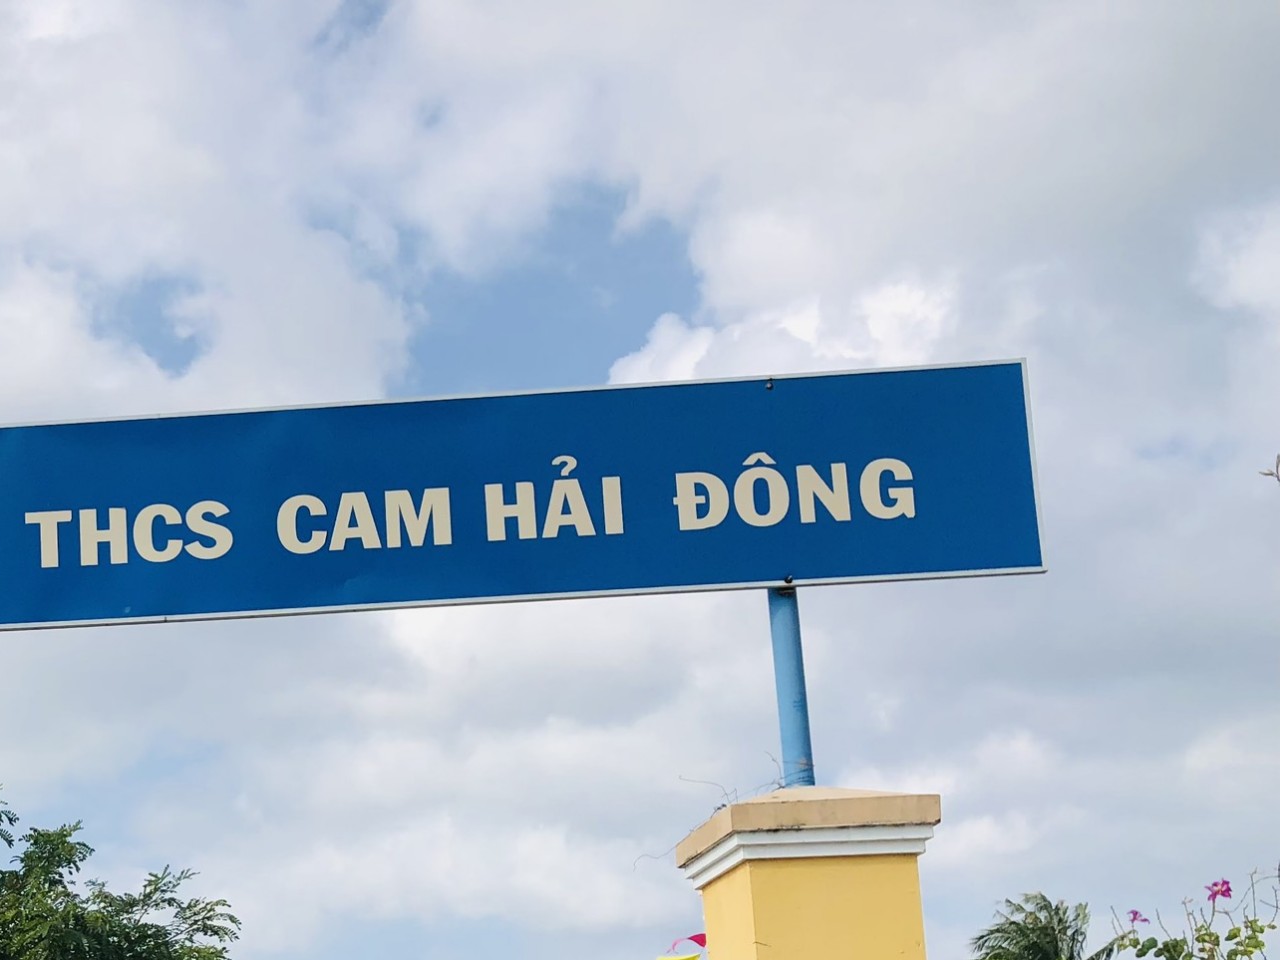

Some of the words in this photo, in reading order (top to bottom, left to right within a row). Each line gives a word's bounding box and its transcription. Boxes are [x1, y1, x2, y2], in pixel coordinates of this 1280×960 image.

[24, 500, 234, 568] THCS
[276, 487, 452, 555] CAM
[484, 455, 624, 542] HẢI
[672, 451, 916, 531] ĐÔNG
